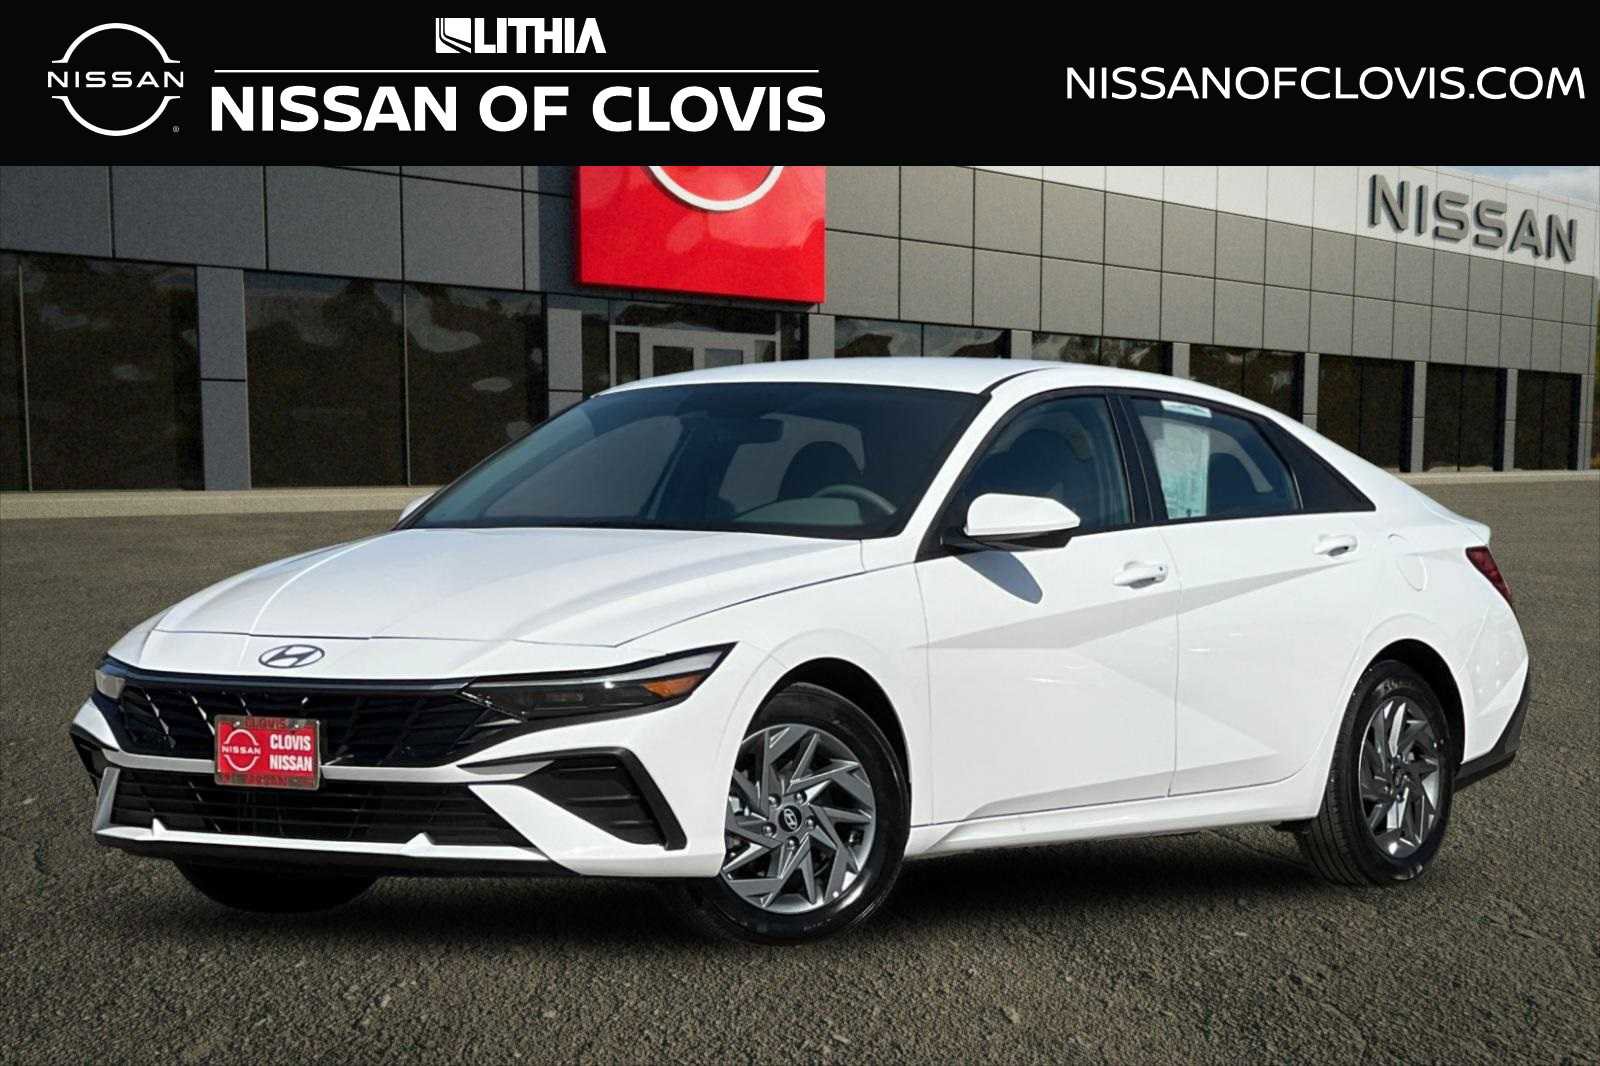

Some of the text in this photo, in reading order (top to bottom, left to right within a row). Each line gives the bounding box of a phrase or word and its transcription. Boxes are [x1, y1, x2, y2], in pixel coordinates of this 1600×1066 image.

[1368, 174, 1578, 263] NISSAN
[222, 745, 261, 755] NISSAN
[269, 734, 312, 751] CLOVIS
[269, 754, 313, 772] NISSAN
